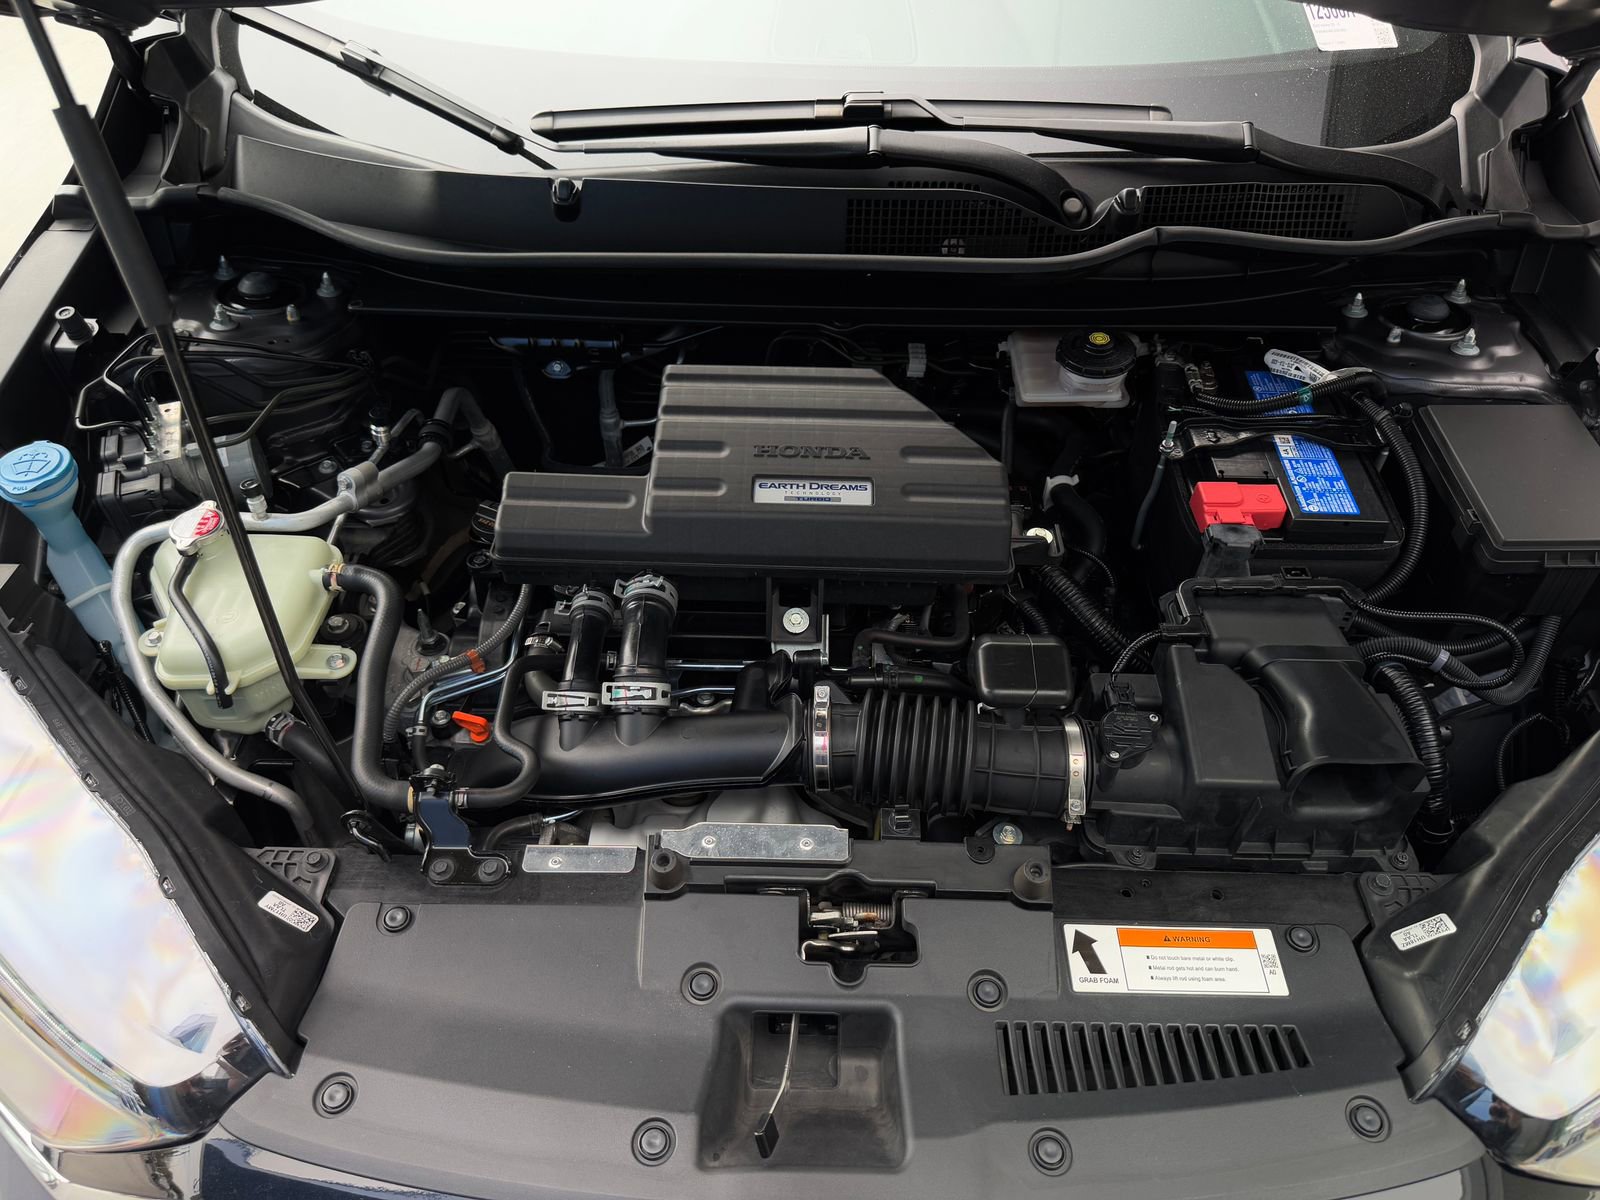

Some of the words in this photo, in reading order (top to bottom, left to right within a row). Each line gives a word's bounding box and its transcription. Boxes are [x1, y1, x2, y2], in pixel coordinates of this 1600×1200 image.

[753, 445, 871, 460] HONDA
[758, 482, 806, 491] EARTH
[809, 482, 868, 492] DREAMS
[1078, 976, 1098, 984] GRAB
